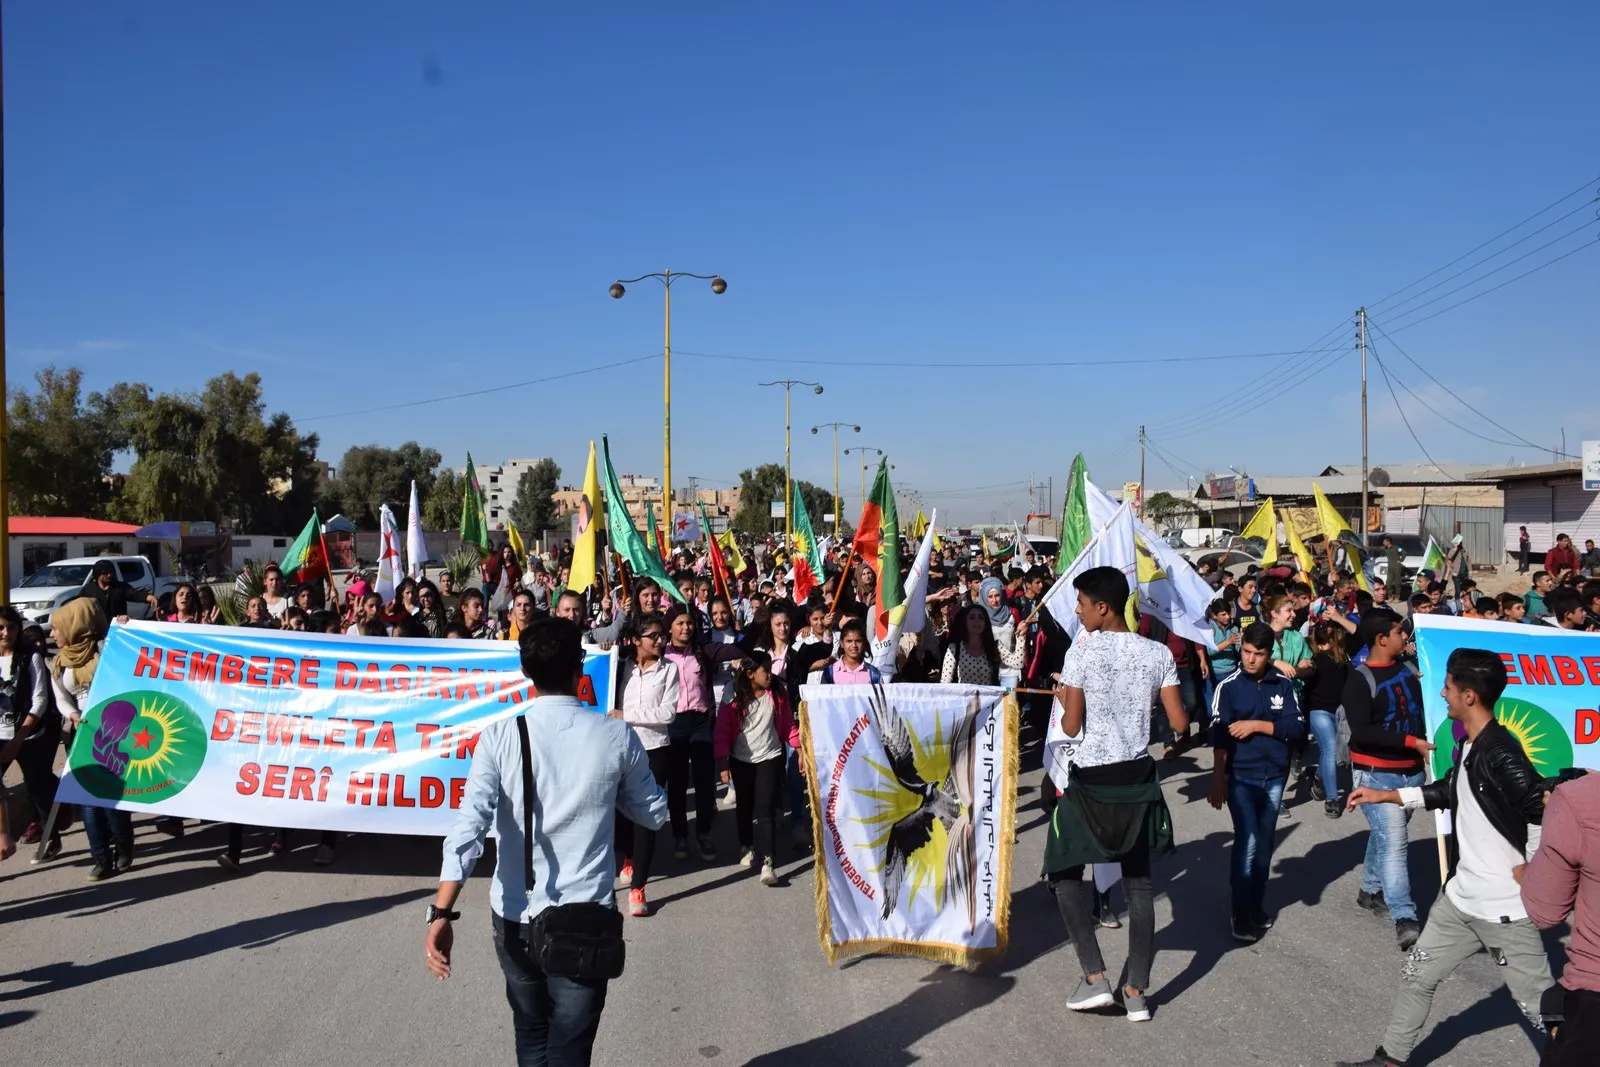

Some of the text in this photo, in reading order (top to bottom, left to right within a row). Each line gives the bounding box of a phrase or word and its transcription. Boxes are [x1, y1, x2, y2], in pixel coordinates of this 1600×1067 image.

[133, 646, 599, 706] HEMBERÊ DAGIRKIRA
[210, 708, 398, 754] DEWLETA
[235, 762, 468, 810] SERÎ HILDE
[982, 757, 995, 812] الطلبة
[840, 857, 876, 900] TEVGERA
